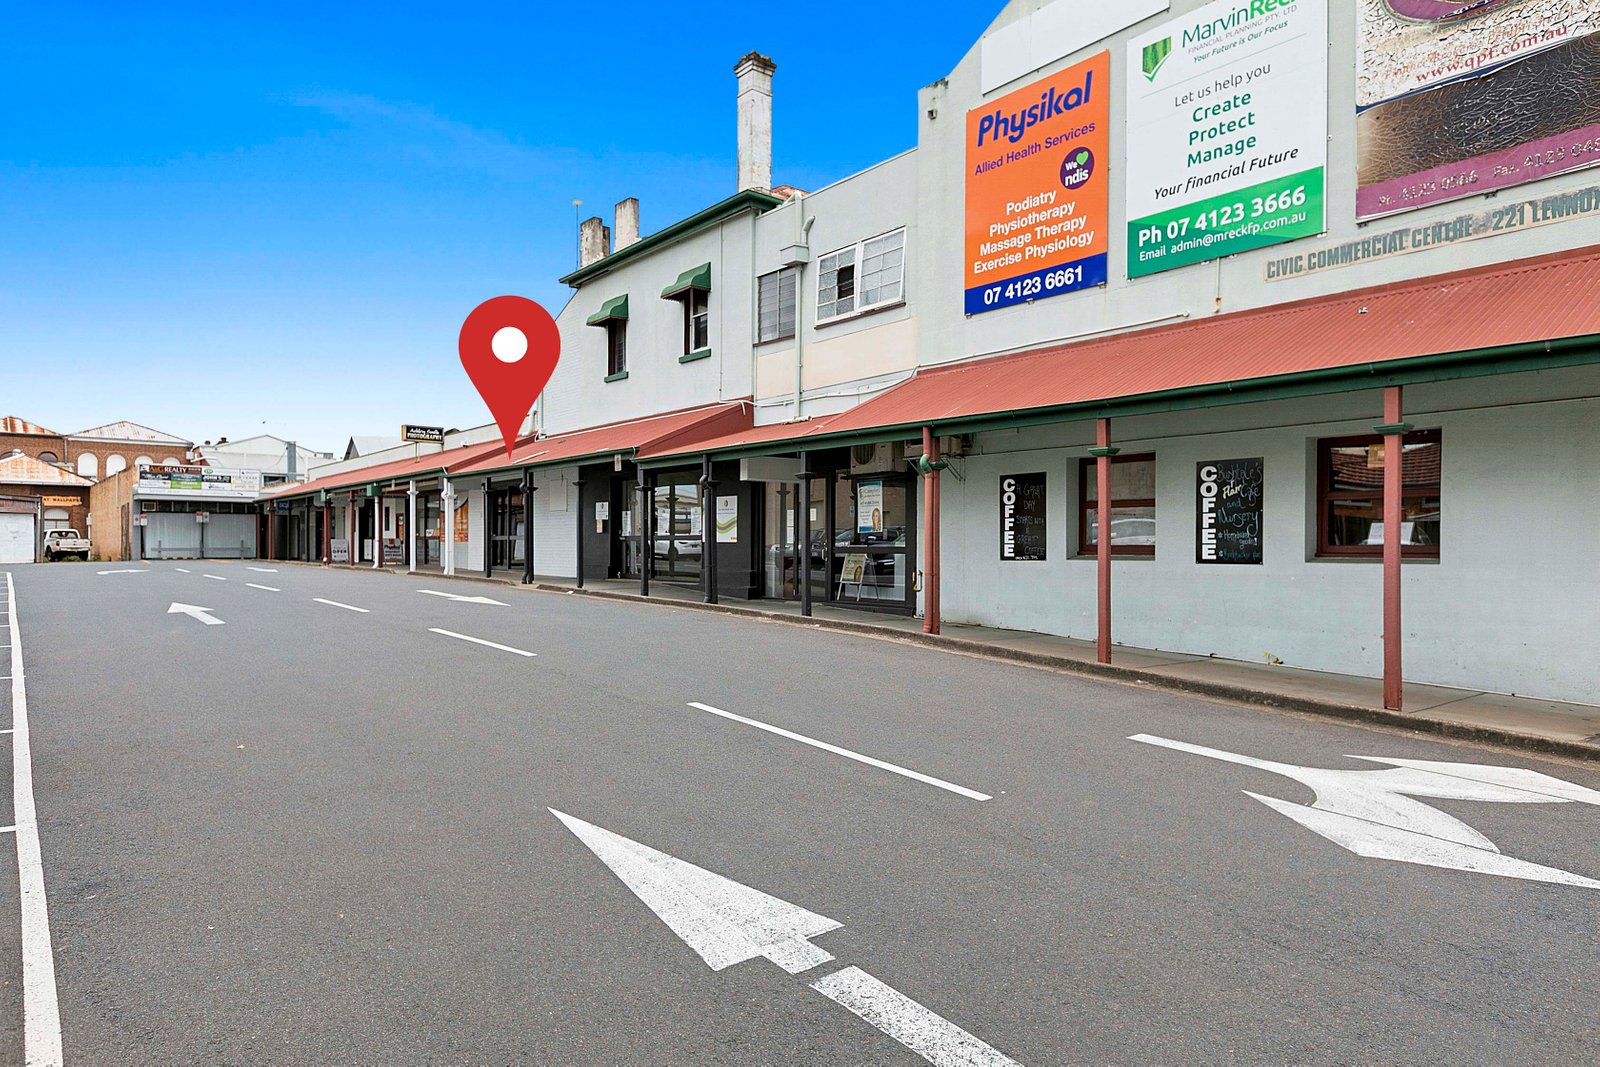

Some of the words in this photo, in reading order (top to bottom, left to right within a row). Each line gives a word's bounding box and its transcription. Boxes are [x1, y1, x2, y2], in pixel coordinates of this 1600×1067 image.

[1182, 0, 1296, 48] MarvinRe
[1187, 36, 1223, 54] FINANCIAL
[1225, 20, 1263, 39] PLANNING
[1283, 5, 1297, 15] LTD
[1193, 52, 1210, 63] Your
[1211, 40, 1238, 57] Future
[1239, 37, 1246, 46] is
[1247, 31, 1262, 42] Our
[1264, 20, 1289, 35] Focus
[1174, 91, 1194, 107] Let
[1197, 86, 1212, 99] us
[1214, 74, 1243, 93] help
[1245, 64, 1271, 84] you
[977, 70, 1093, 147] Physikal
[1188, 111, 1256, 146] Protect
[1192, 93, 1252, 122] Create
[974, 156, 1004, 176] Allied
[1006, 142, 1042, 164] Health
[1044, 122, 1096, 149] Services
[1064, 160, 1078, 171] We
[1187, 135, 1257, 168] Manage
[1064, 169, 1089, 187] ndis
[1154, 183, 1183, 200] Your
[1184, 160, 1246, 194] financial
[1248, 148, 1299, 172] Future
[989, 201, 1076, 237] Physiotherapy
[1006, 190, 1057, 215] Podiatry
[1138, 225, 1162, 247] Ph
[1166, 217, 1191, 239] 07
[1194, 203, 1246, 231] 4123
[1250, 185, 1307, 218] 3666
[973, 251, 1022, 274] Exercise
[1024, 231, 1095, 259] Physiology
[980, 232, 1032, 256] Massage
[1034, 215, 1087, 239] Therapy
[1139, 245, 1167, 262] Email
[1170, 211, 1307, 254] admin@mreckfp.com.au
[1266, 254, 1304, 279] CIVIC
[1308, 229, 1405, 271] COMMERCIAL
[1411, 217, 1473, 249] CENTRE
[1492, 202, 1525, 231] 221
[983, 286, 1002, 305] 07
[1004, 276, 1042, 299] 4123
[1044, 265, 1083, 290] 6661
[1003, 478, 1016, 557] COFFEE
[1200, 465, 1218, 560] COFFEE
